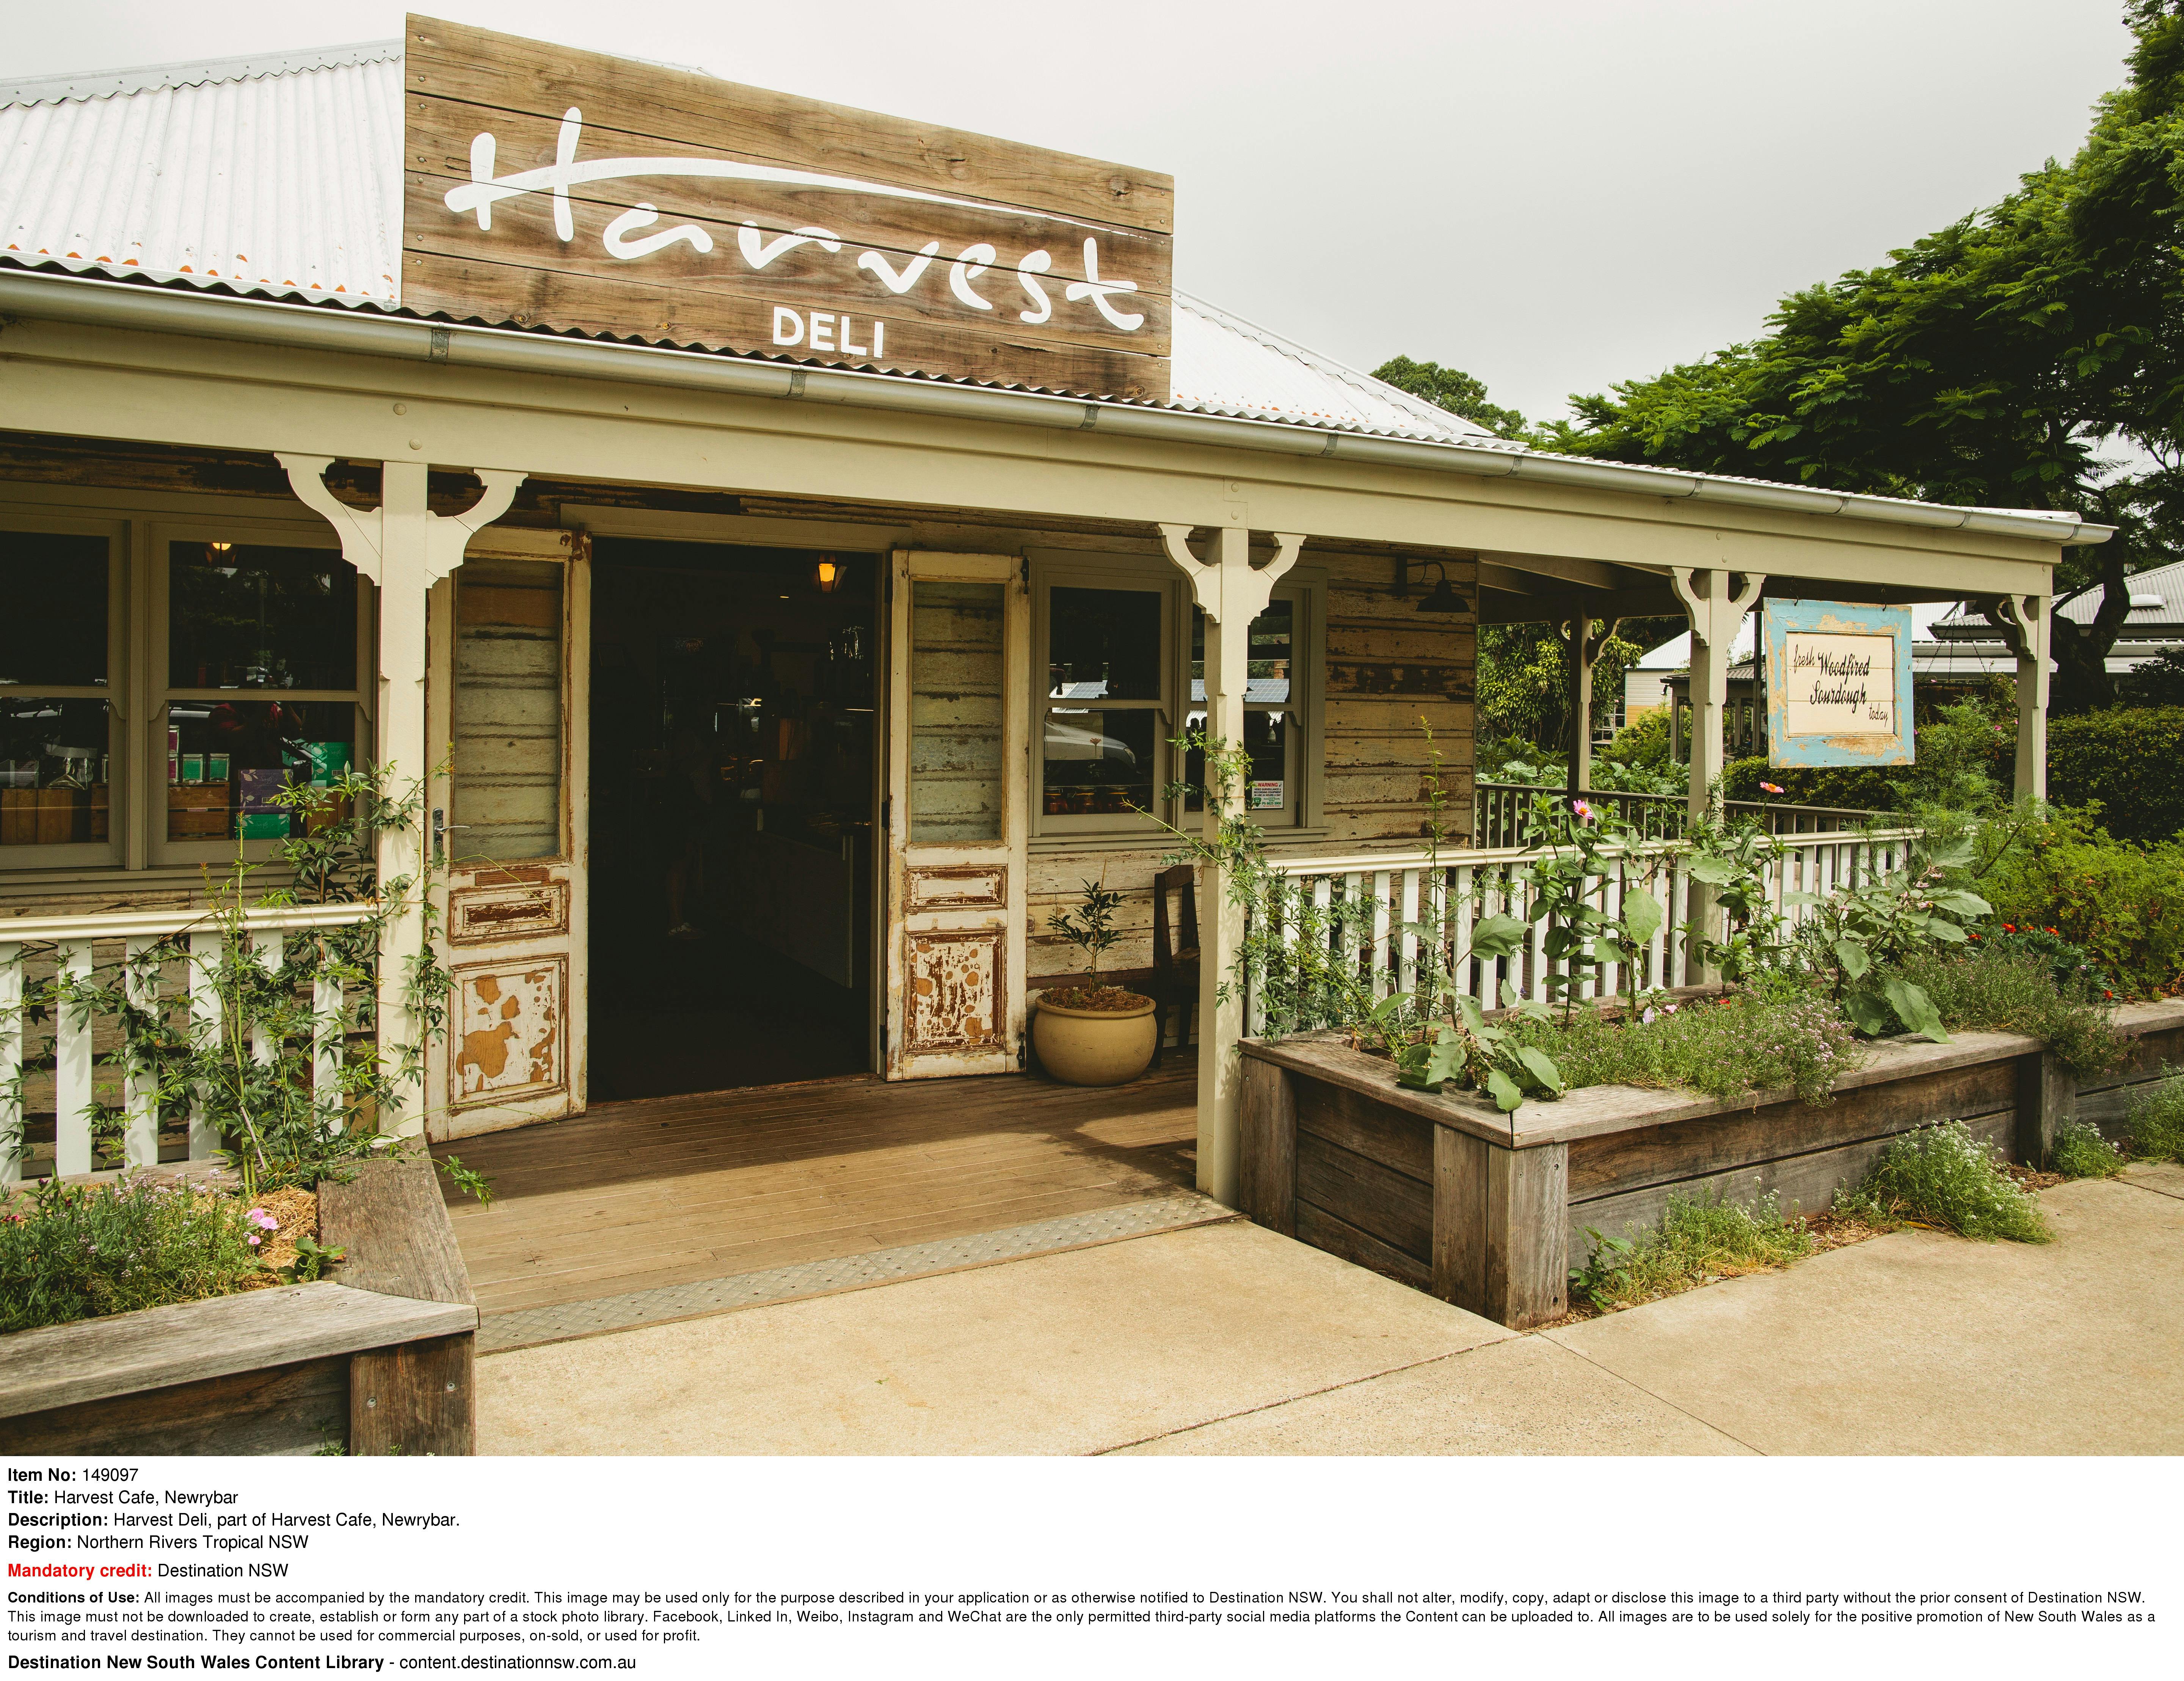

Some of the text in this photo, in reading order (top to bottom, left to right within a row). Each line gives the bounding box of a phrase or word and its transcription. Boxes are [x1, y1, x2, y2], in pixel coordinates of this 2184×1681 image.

[444, 106, 1152, 331] Harvest
[772, 306, 884, 358] DELI
[1793, 644, 1870, 685] fresh Woodfired
[1810, 680, 1867, 714] Sourdough
[1869, 702, 1888, 728] today
